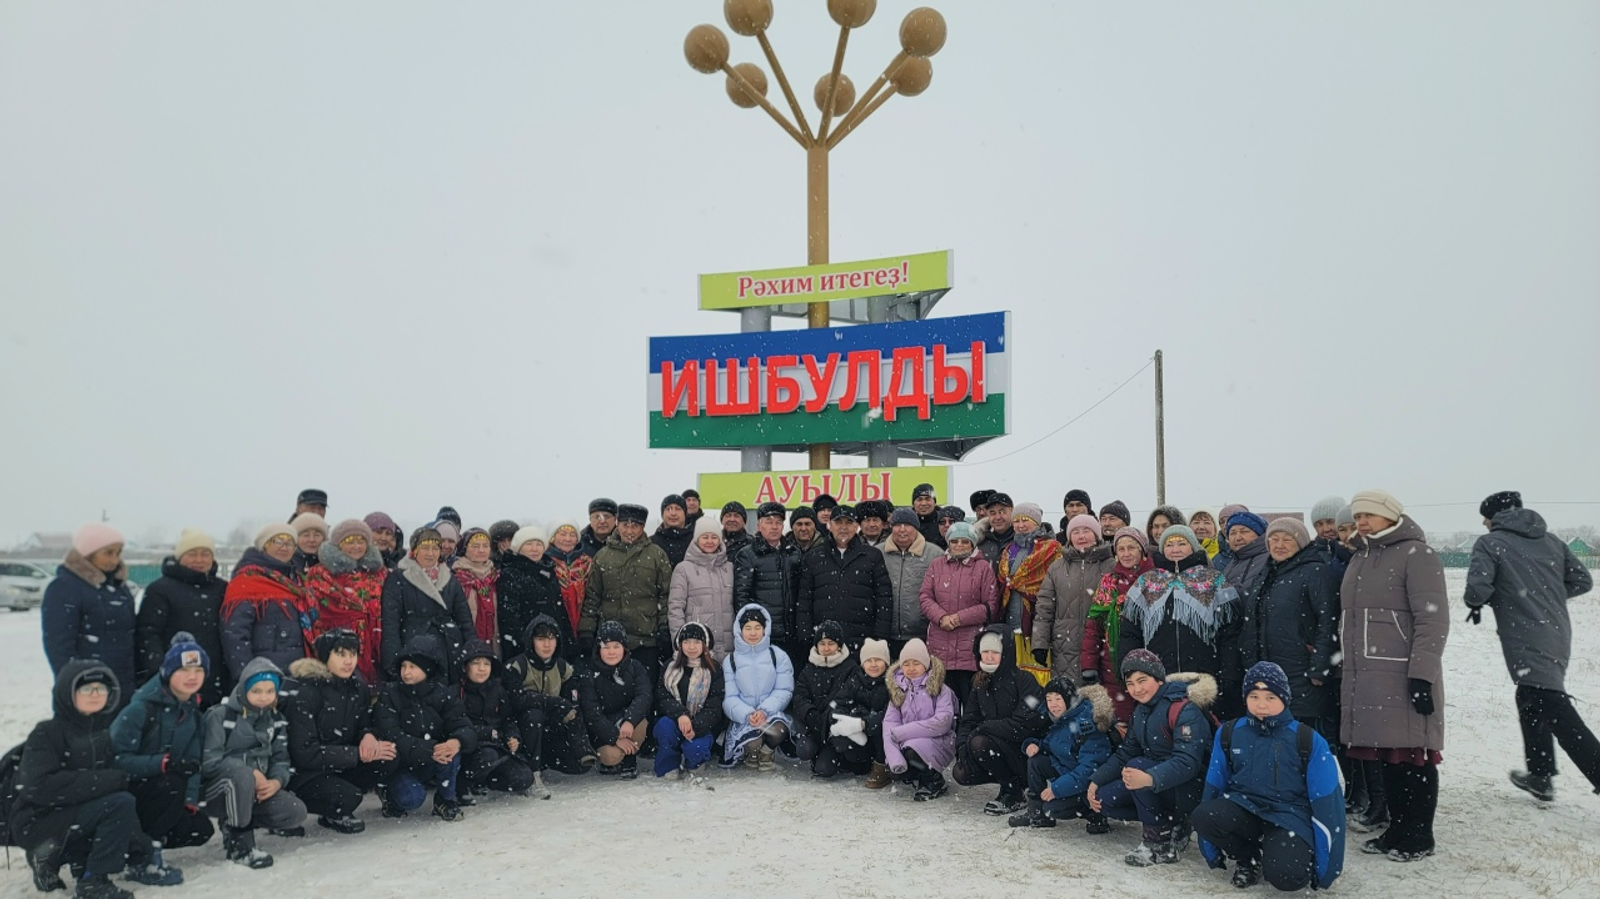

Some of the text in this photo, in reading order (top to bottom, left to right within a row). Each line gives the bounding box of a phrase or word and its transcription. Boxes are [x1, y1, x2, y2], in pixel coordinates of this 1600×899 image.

[738, 276, 813, 298] Рәхим
[661, 340, 986, 422] ИШБУЛДЫ
[754, 472, 891, 504] АУЫЛЫ
